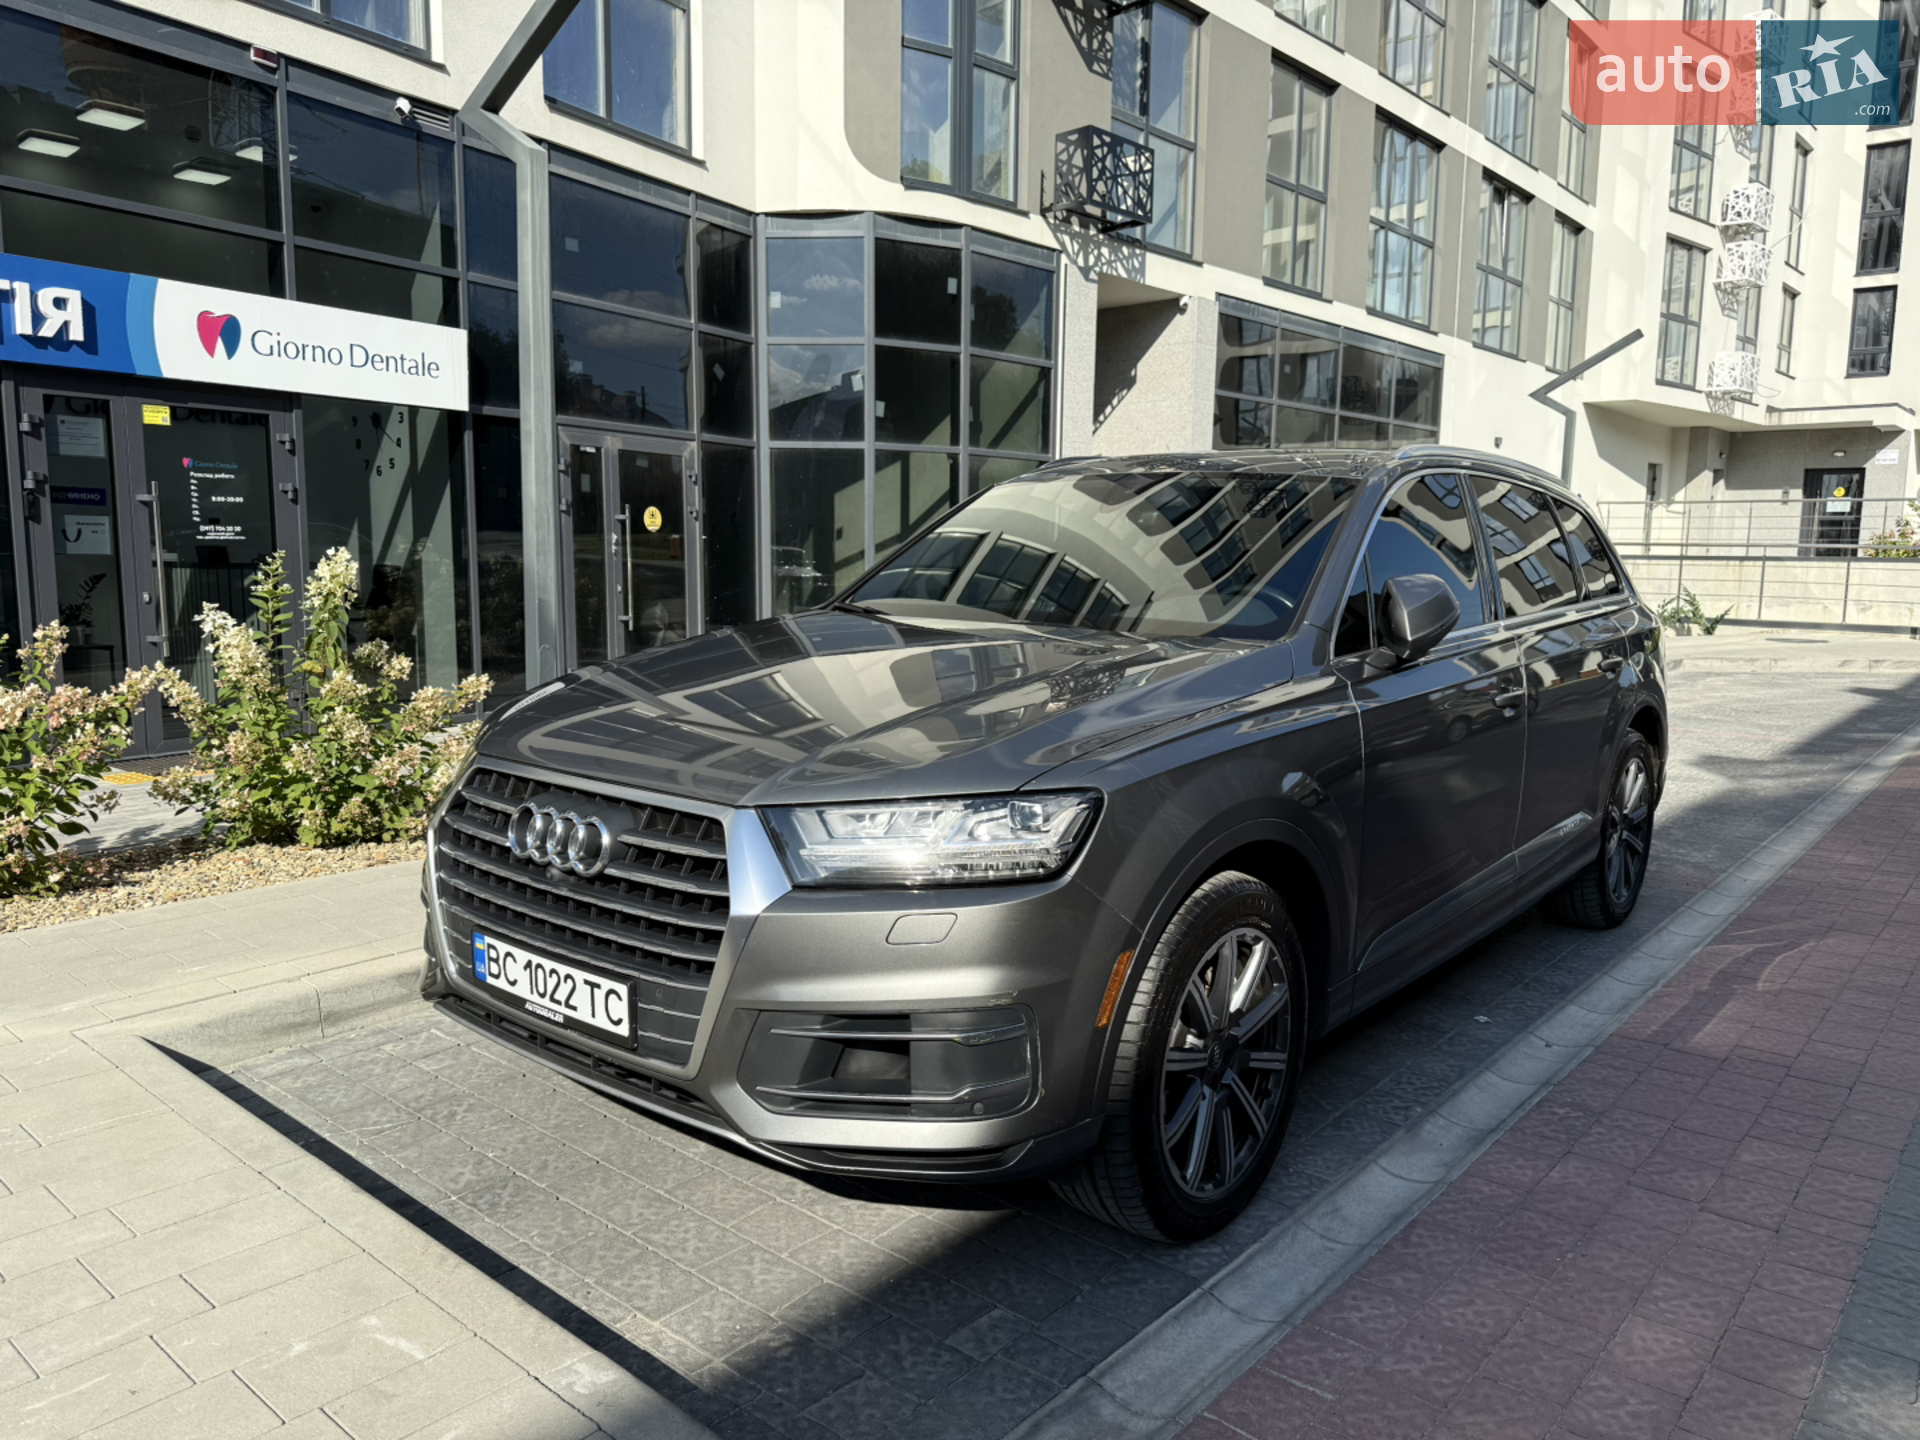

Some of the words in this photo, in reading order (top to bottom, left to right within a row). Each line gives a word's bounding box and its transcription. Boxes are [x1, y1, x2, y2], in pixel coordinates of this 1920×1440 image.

[250, 329, 344, 366] Giorno
[349, 343, 440, 379] Dentale
[398, 411, 404, 423] 3
[364, 459, 370, 470] 7
[389, 458, 395, 469] 5
[376, 465, 382, 476] 6
[487, 943, 518, 987] BC
[522, 959, 578, 1013] 1022
[582, 978, 624, 1027] TC
